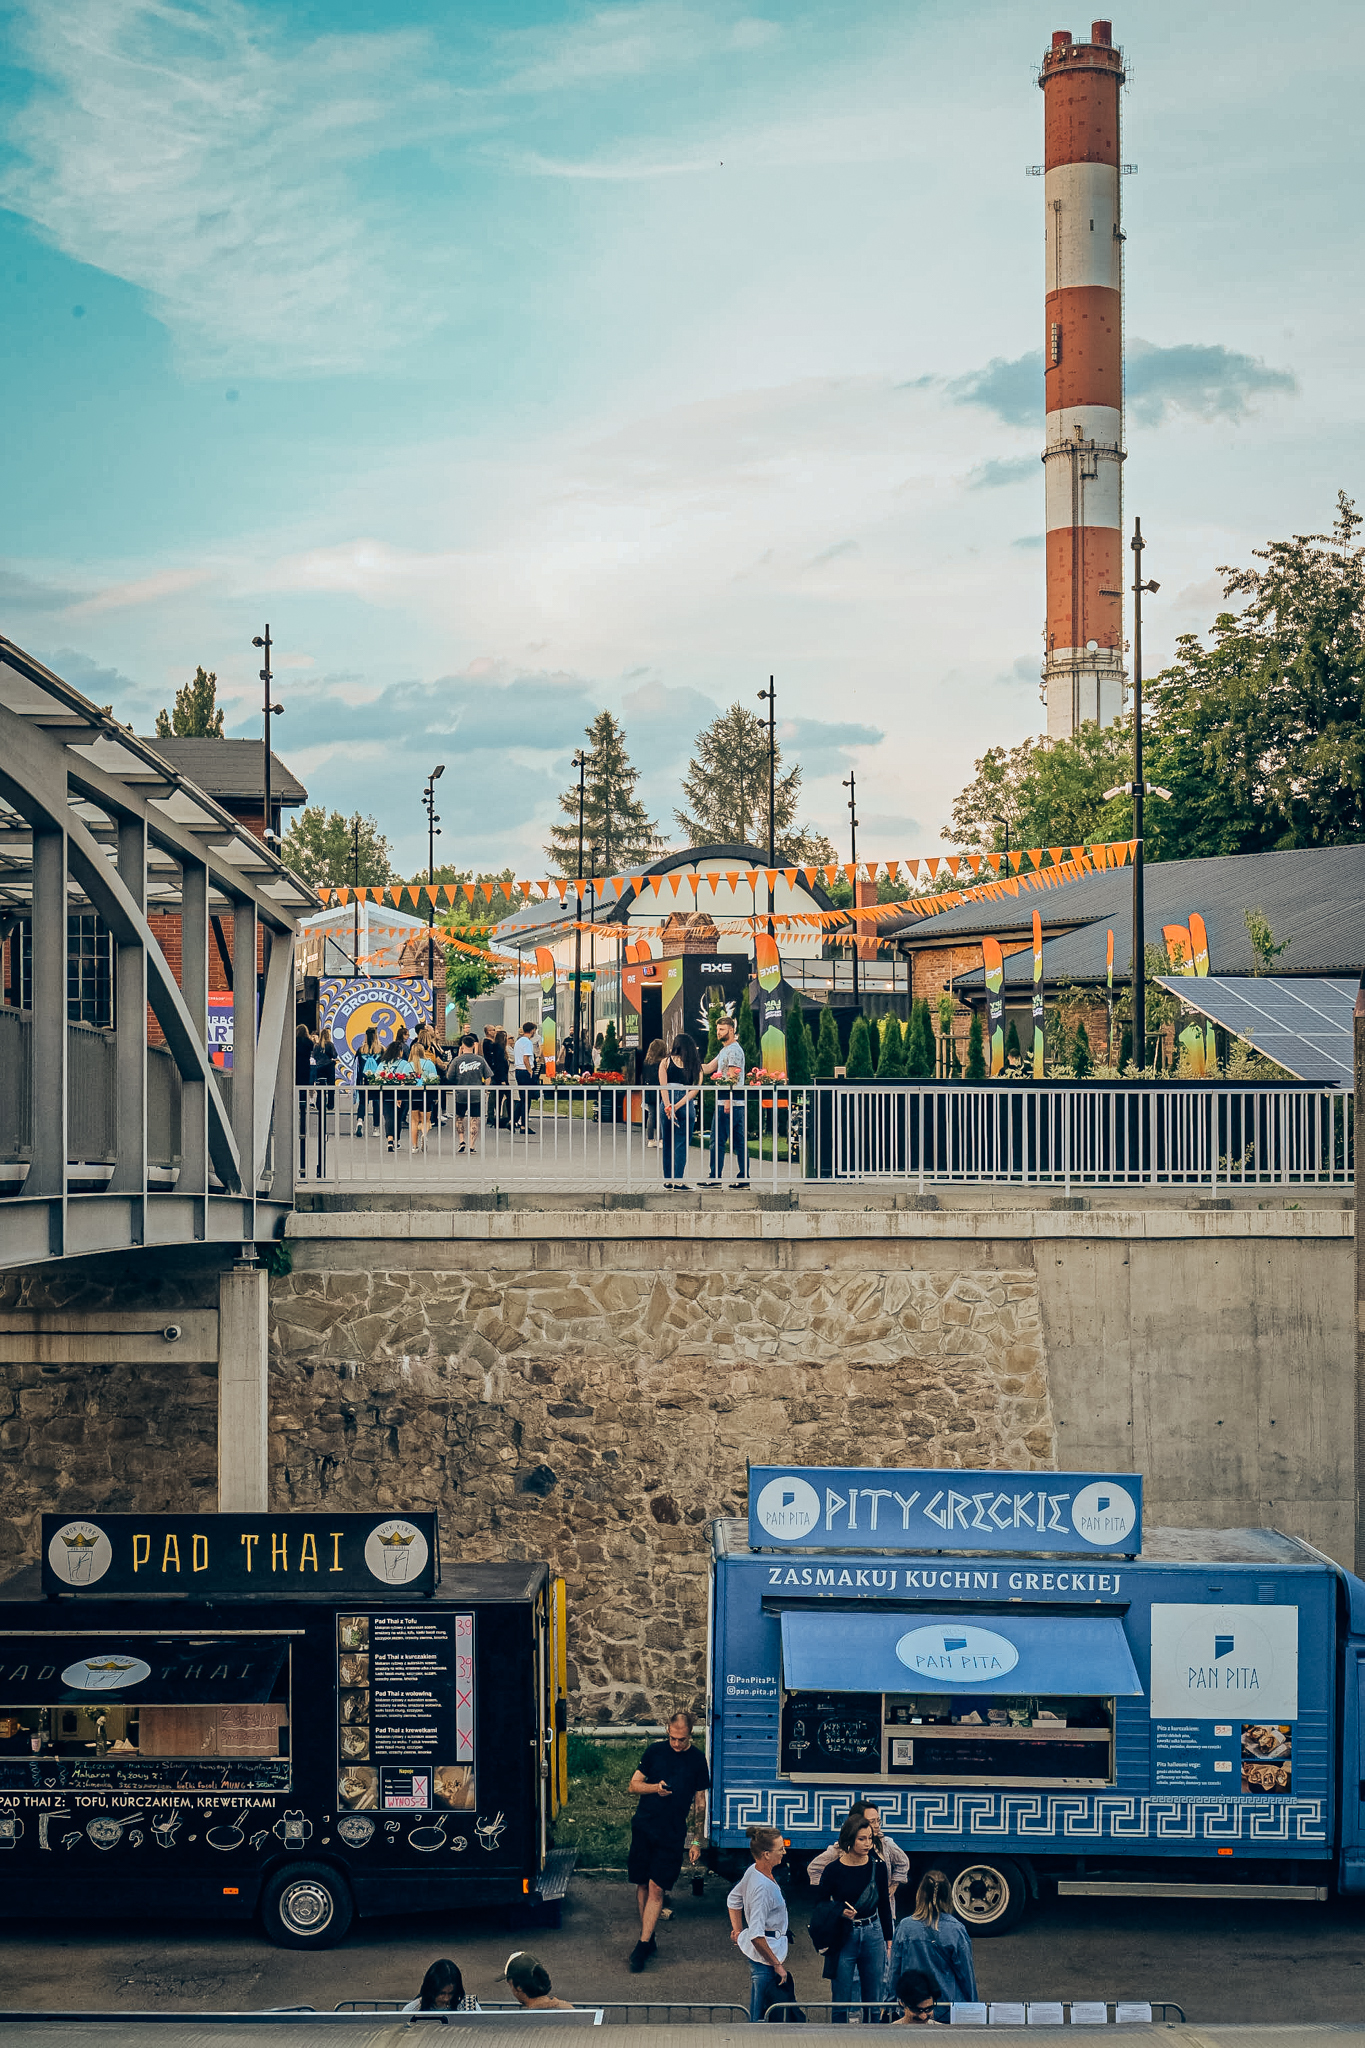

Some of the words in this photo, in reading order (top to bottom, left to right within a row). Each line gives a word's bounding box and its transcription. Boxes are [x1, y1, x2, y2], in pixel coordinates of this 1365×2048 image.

[700, 963, 732, 973] AXE
[340, 991, 412, 1017] BROOKLYN
[825, 1487, 921, 1531] PITY
[922, 1489, 1070, 1534] GRECKIE
[766, 1511, 785, 1526] PAN
[789, 1511, 810, 1526] PITA
[1081, 1516, 1101, 1531] PAN
[1104, 1517, 1126, 1531] PITA
[132, 1533, 208, 1573] PAD
[241, 1533, 344, 1573] THAI
[768, 1567, 897, 1591] ZASMAKUJ
[905, 1571, 999, 1589] KUCHNI
[1008, 1572, 1121, 1595] GRECKIEJ
[915, 1655, 952, 1668] PAN
[961, 1656, 1002, 1669] PITA
[161, 1663, 255, 1680] THAI
[1188, 1667, 1218, 1688] PAN
[1226, 1667, 1259, 1689] PITA
[736, 1676, 777, 1684] PanPitaPL
[736, 1688, 777, 1696] pan.pita.pl
[23, 1796, 51, 1807] THAI
[54, 1796, 66, 1807] Z:
[75, 1796, 109, 1808] TOFU,
[111, 1796, 194, 1808] KURCZAKIEM,
[197, 1797, 276, 1808] KREWETKAMI
